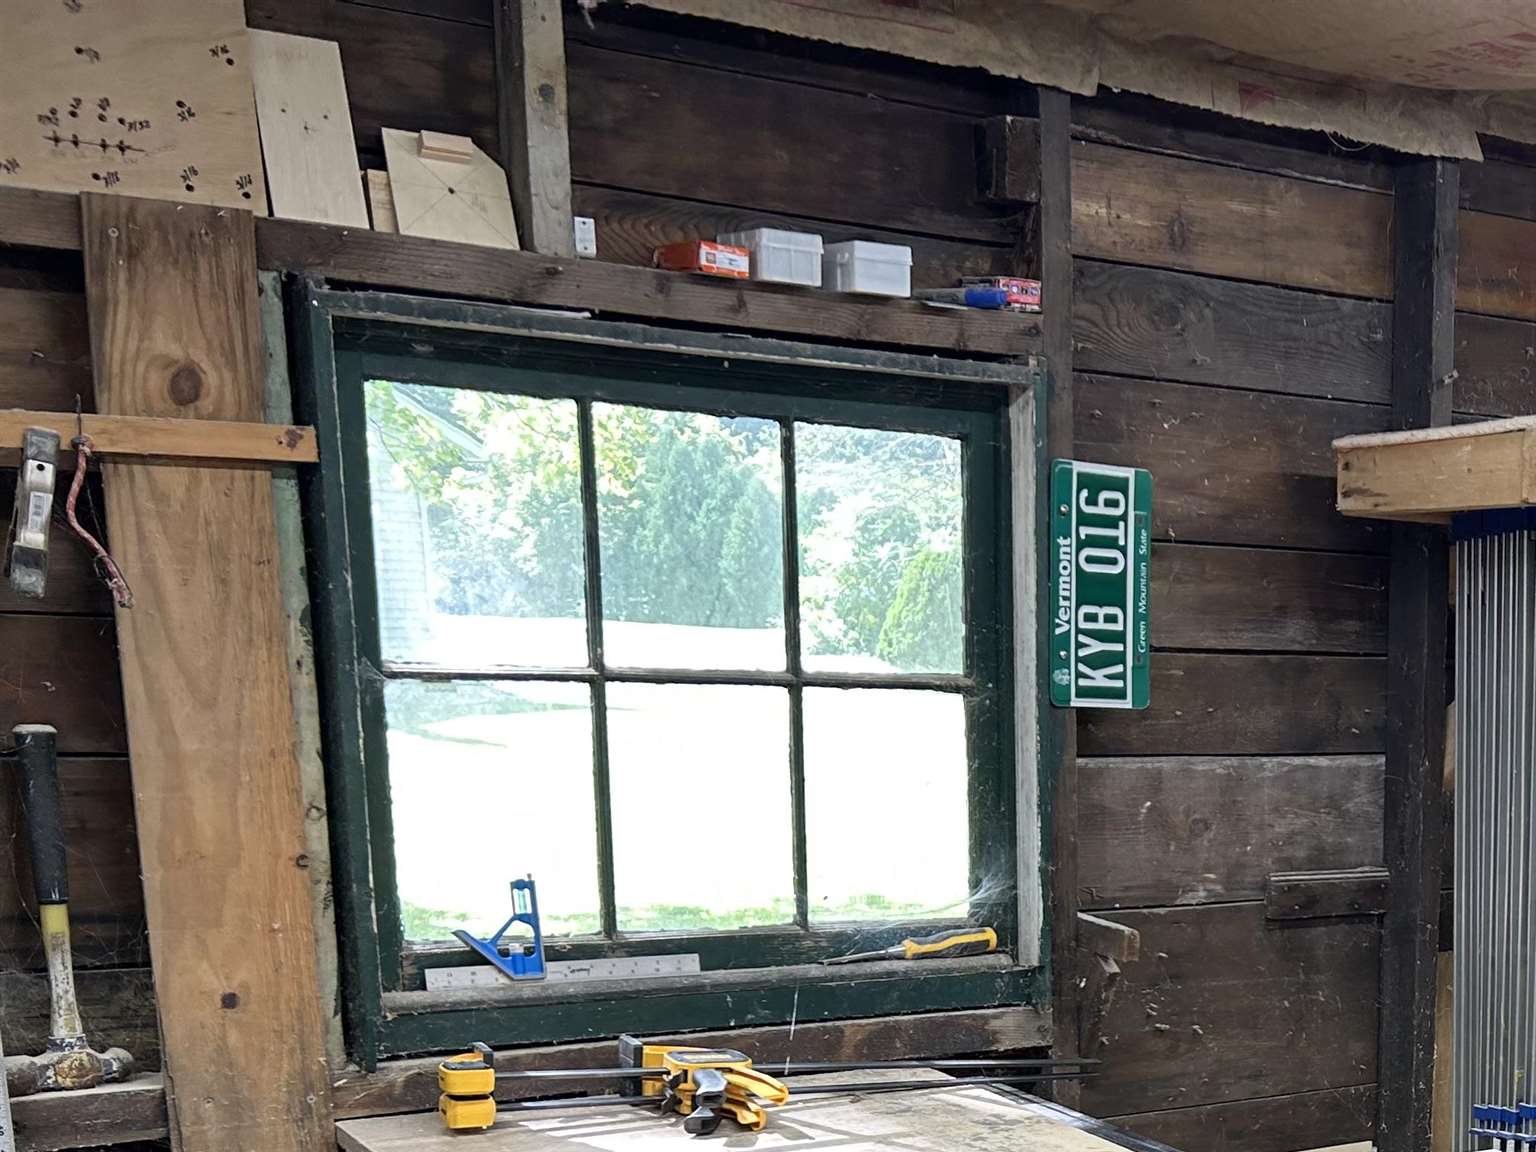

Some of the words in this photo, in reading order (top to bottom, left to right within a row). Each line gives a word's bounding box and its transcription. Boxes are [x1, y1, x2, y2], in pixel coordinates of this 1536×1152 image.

[1077, 488, 1126, 575] 016
[1139, 528, 1148, 555] State
[1054, 535, 1072, 635] Vermont
[1138, 562, 1148, 614] Mountain
[1077, 605, 1125, 688] KYB
[1137, 619, 1147, 654] Green
